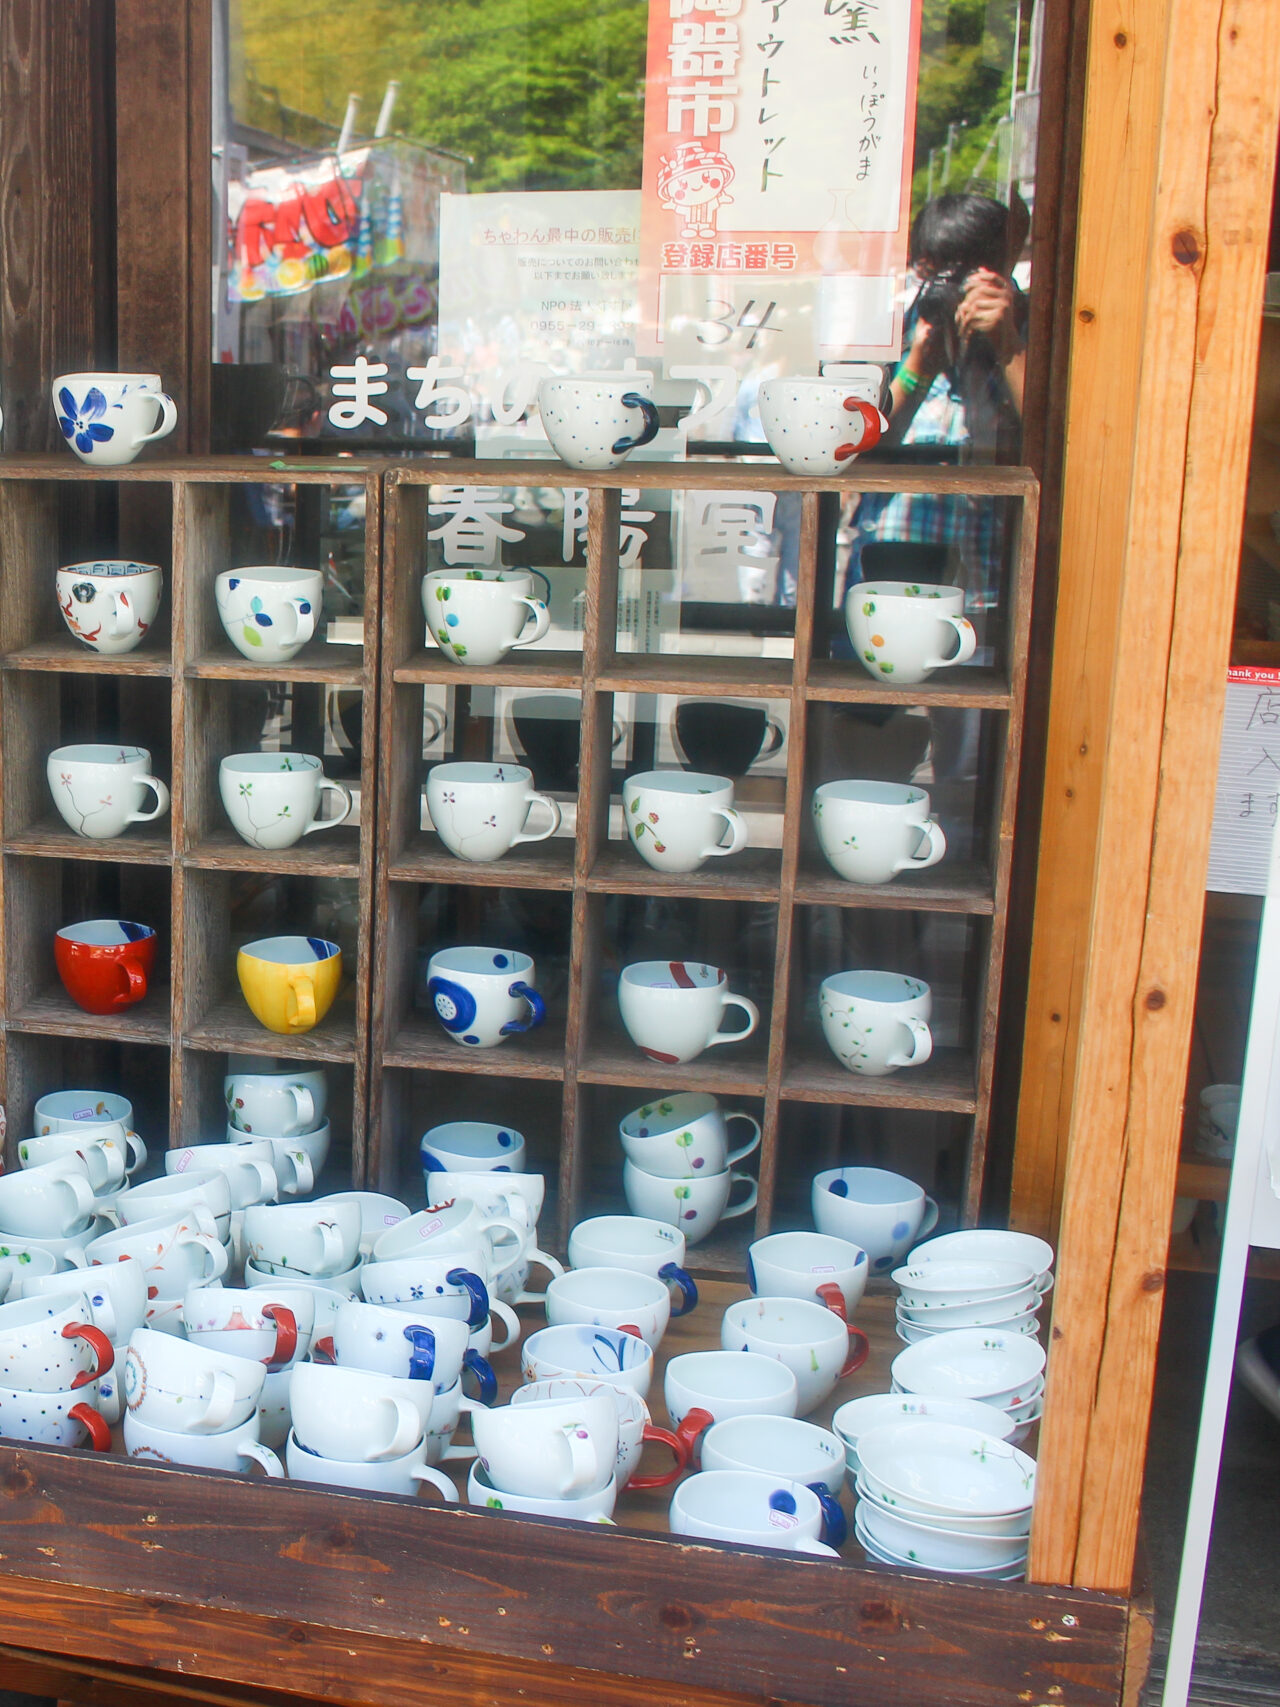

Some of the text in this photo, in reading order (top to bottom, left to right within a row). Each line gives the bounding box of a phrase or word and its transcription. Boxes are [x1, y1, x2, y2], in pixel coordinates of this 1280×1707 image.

[855, 64, 886, 181] いっぽうがま
[662, 242, 798, 271] 登録店番号
[541, 300, 567, 312] NPO
[696, 299, 784, 350] 34
[1254, 671, 1275, 679] you
